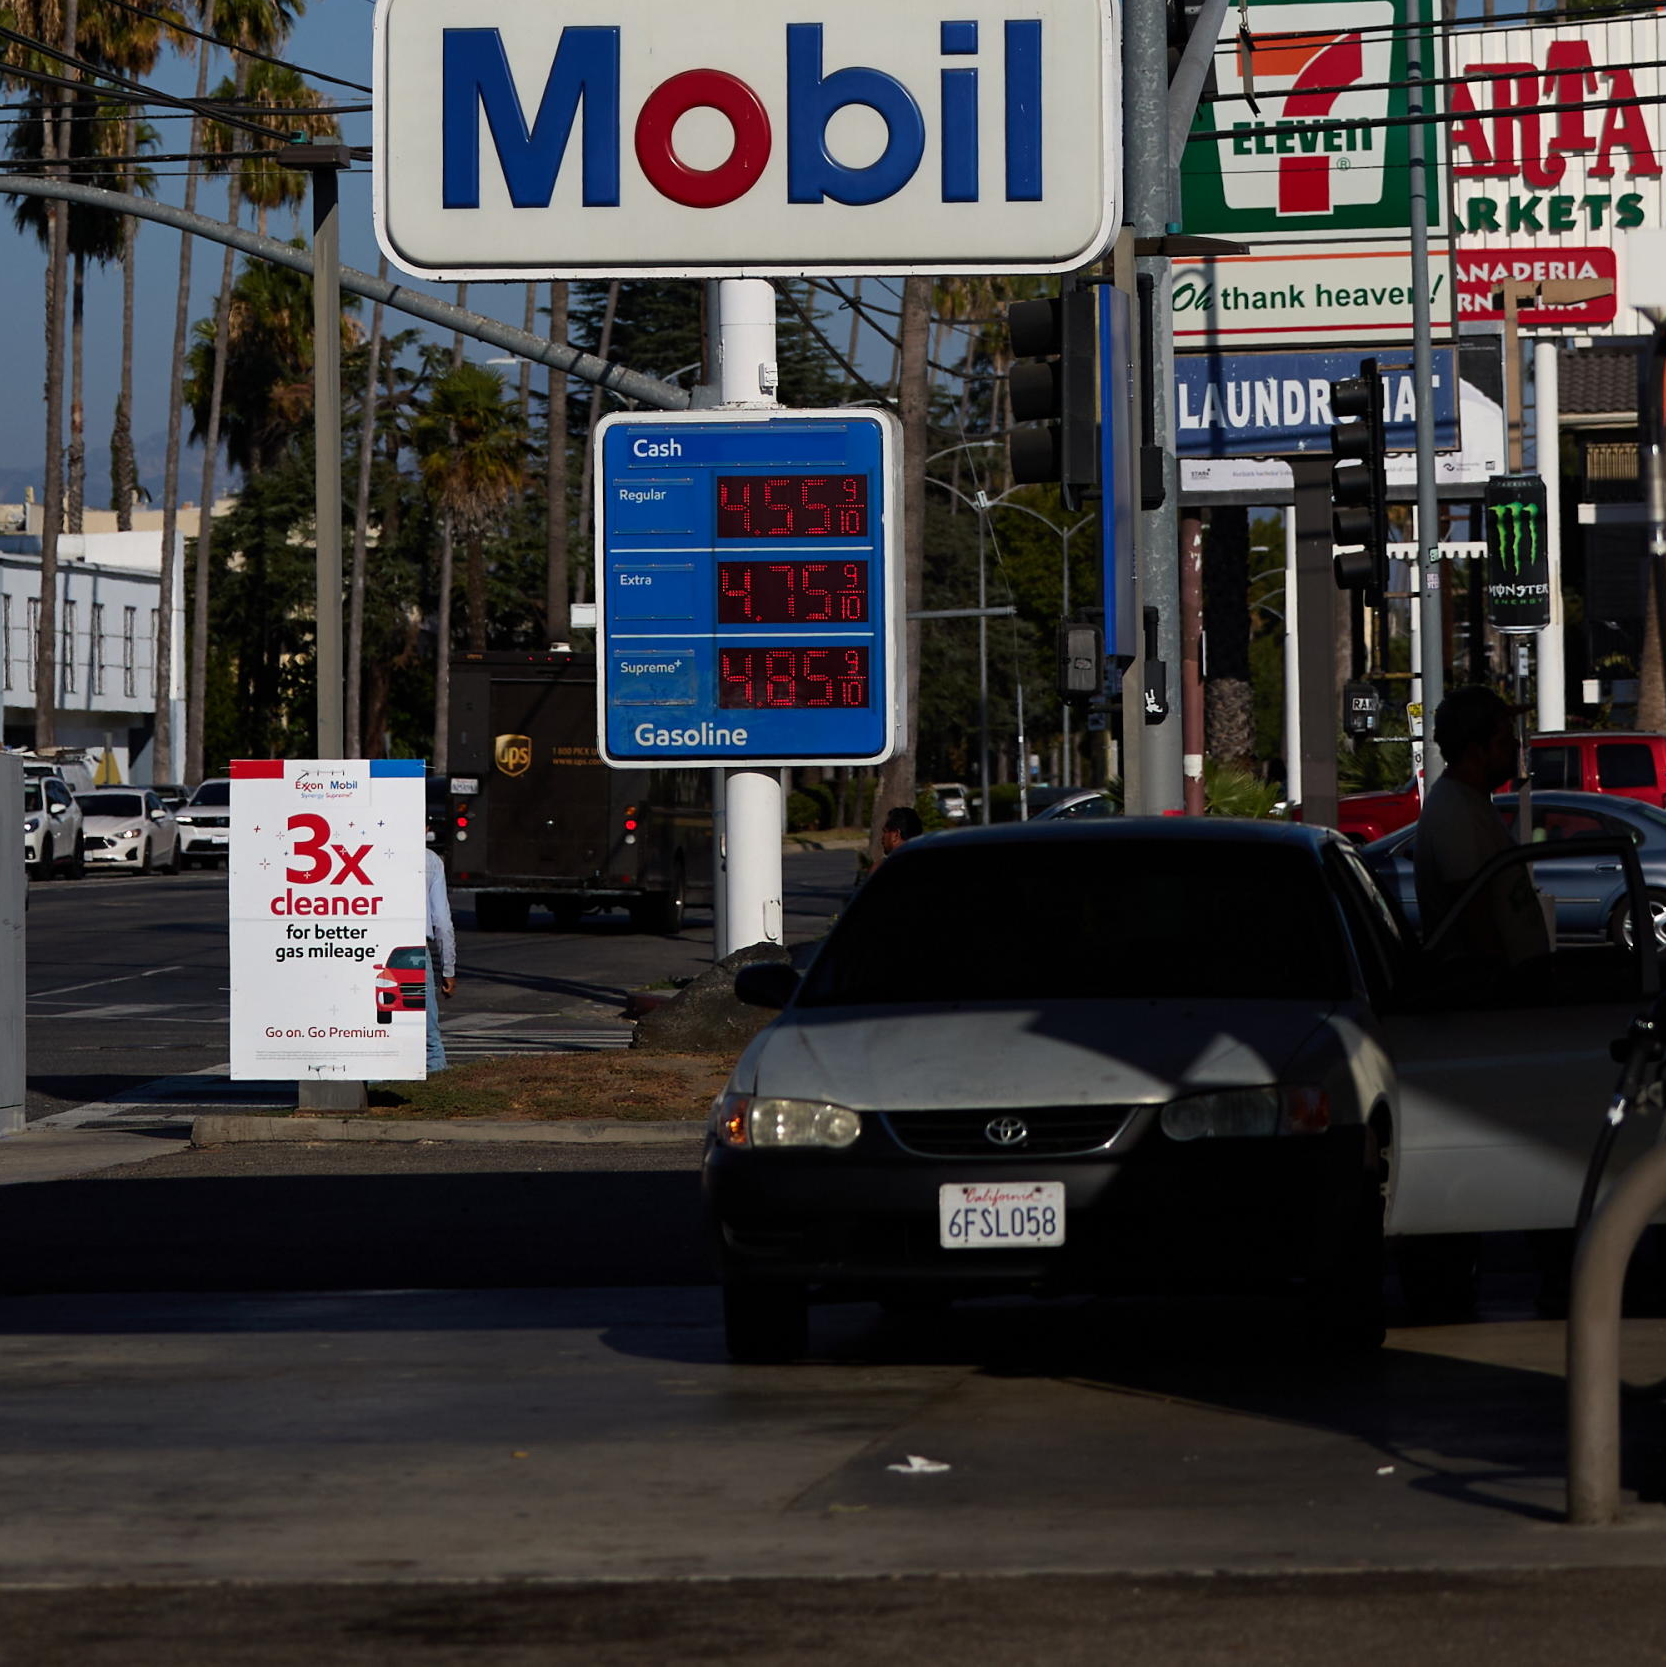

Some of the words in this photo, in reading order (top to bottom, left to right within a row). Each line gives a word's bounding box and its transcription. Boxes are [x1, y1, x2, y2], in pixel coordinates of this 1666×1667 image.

[442, 18, 1043, 210] Mobil
[1172, 282, 1214, 312] Oh
[1221, 285, 1305, 311] thank
[633, 438, 682, 458] Cash
[619, 489, 667, 502] Regular
[721, 479, 831, 534] 4.55
[620, 574, 652, 586] Extra
[1488, 584, 1549, 598] MONSTER
[722, 565, 831, 622] 4.75
[723, 651, 832, 707] 4.85
[634, 722, 748, 747] Gasoline
[498, 747, 528, 769] ups
[295, 780, 323, 792] Exxon
[330, 780, 358, 790] Mobil
[286, 813, 374, 885] 3x
[270, 888, 383, 916] cleaner
[287, 924, 310, 939] for
[315, 924, 368, 939] better
[276, 947, 304, 962] gas
[266, 1027, 282, 1038] Go
[286, 1029, 304, 1038] on.
[308, 1027, 325, 1038] Go
[329, 1027, 390, 1038] Premium.
[966, 1187, 1035, 1206] California
[949, 1207, 1055, 1237] 6FSL058
